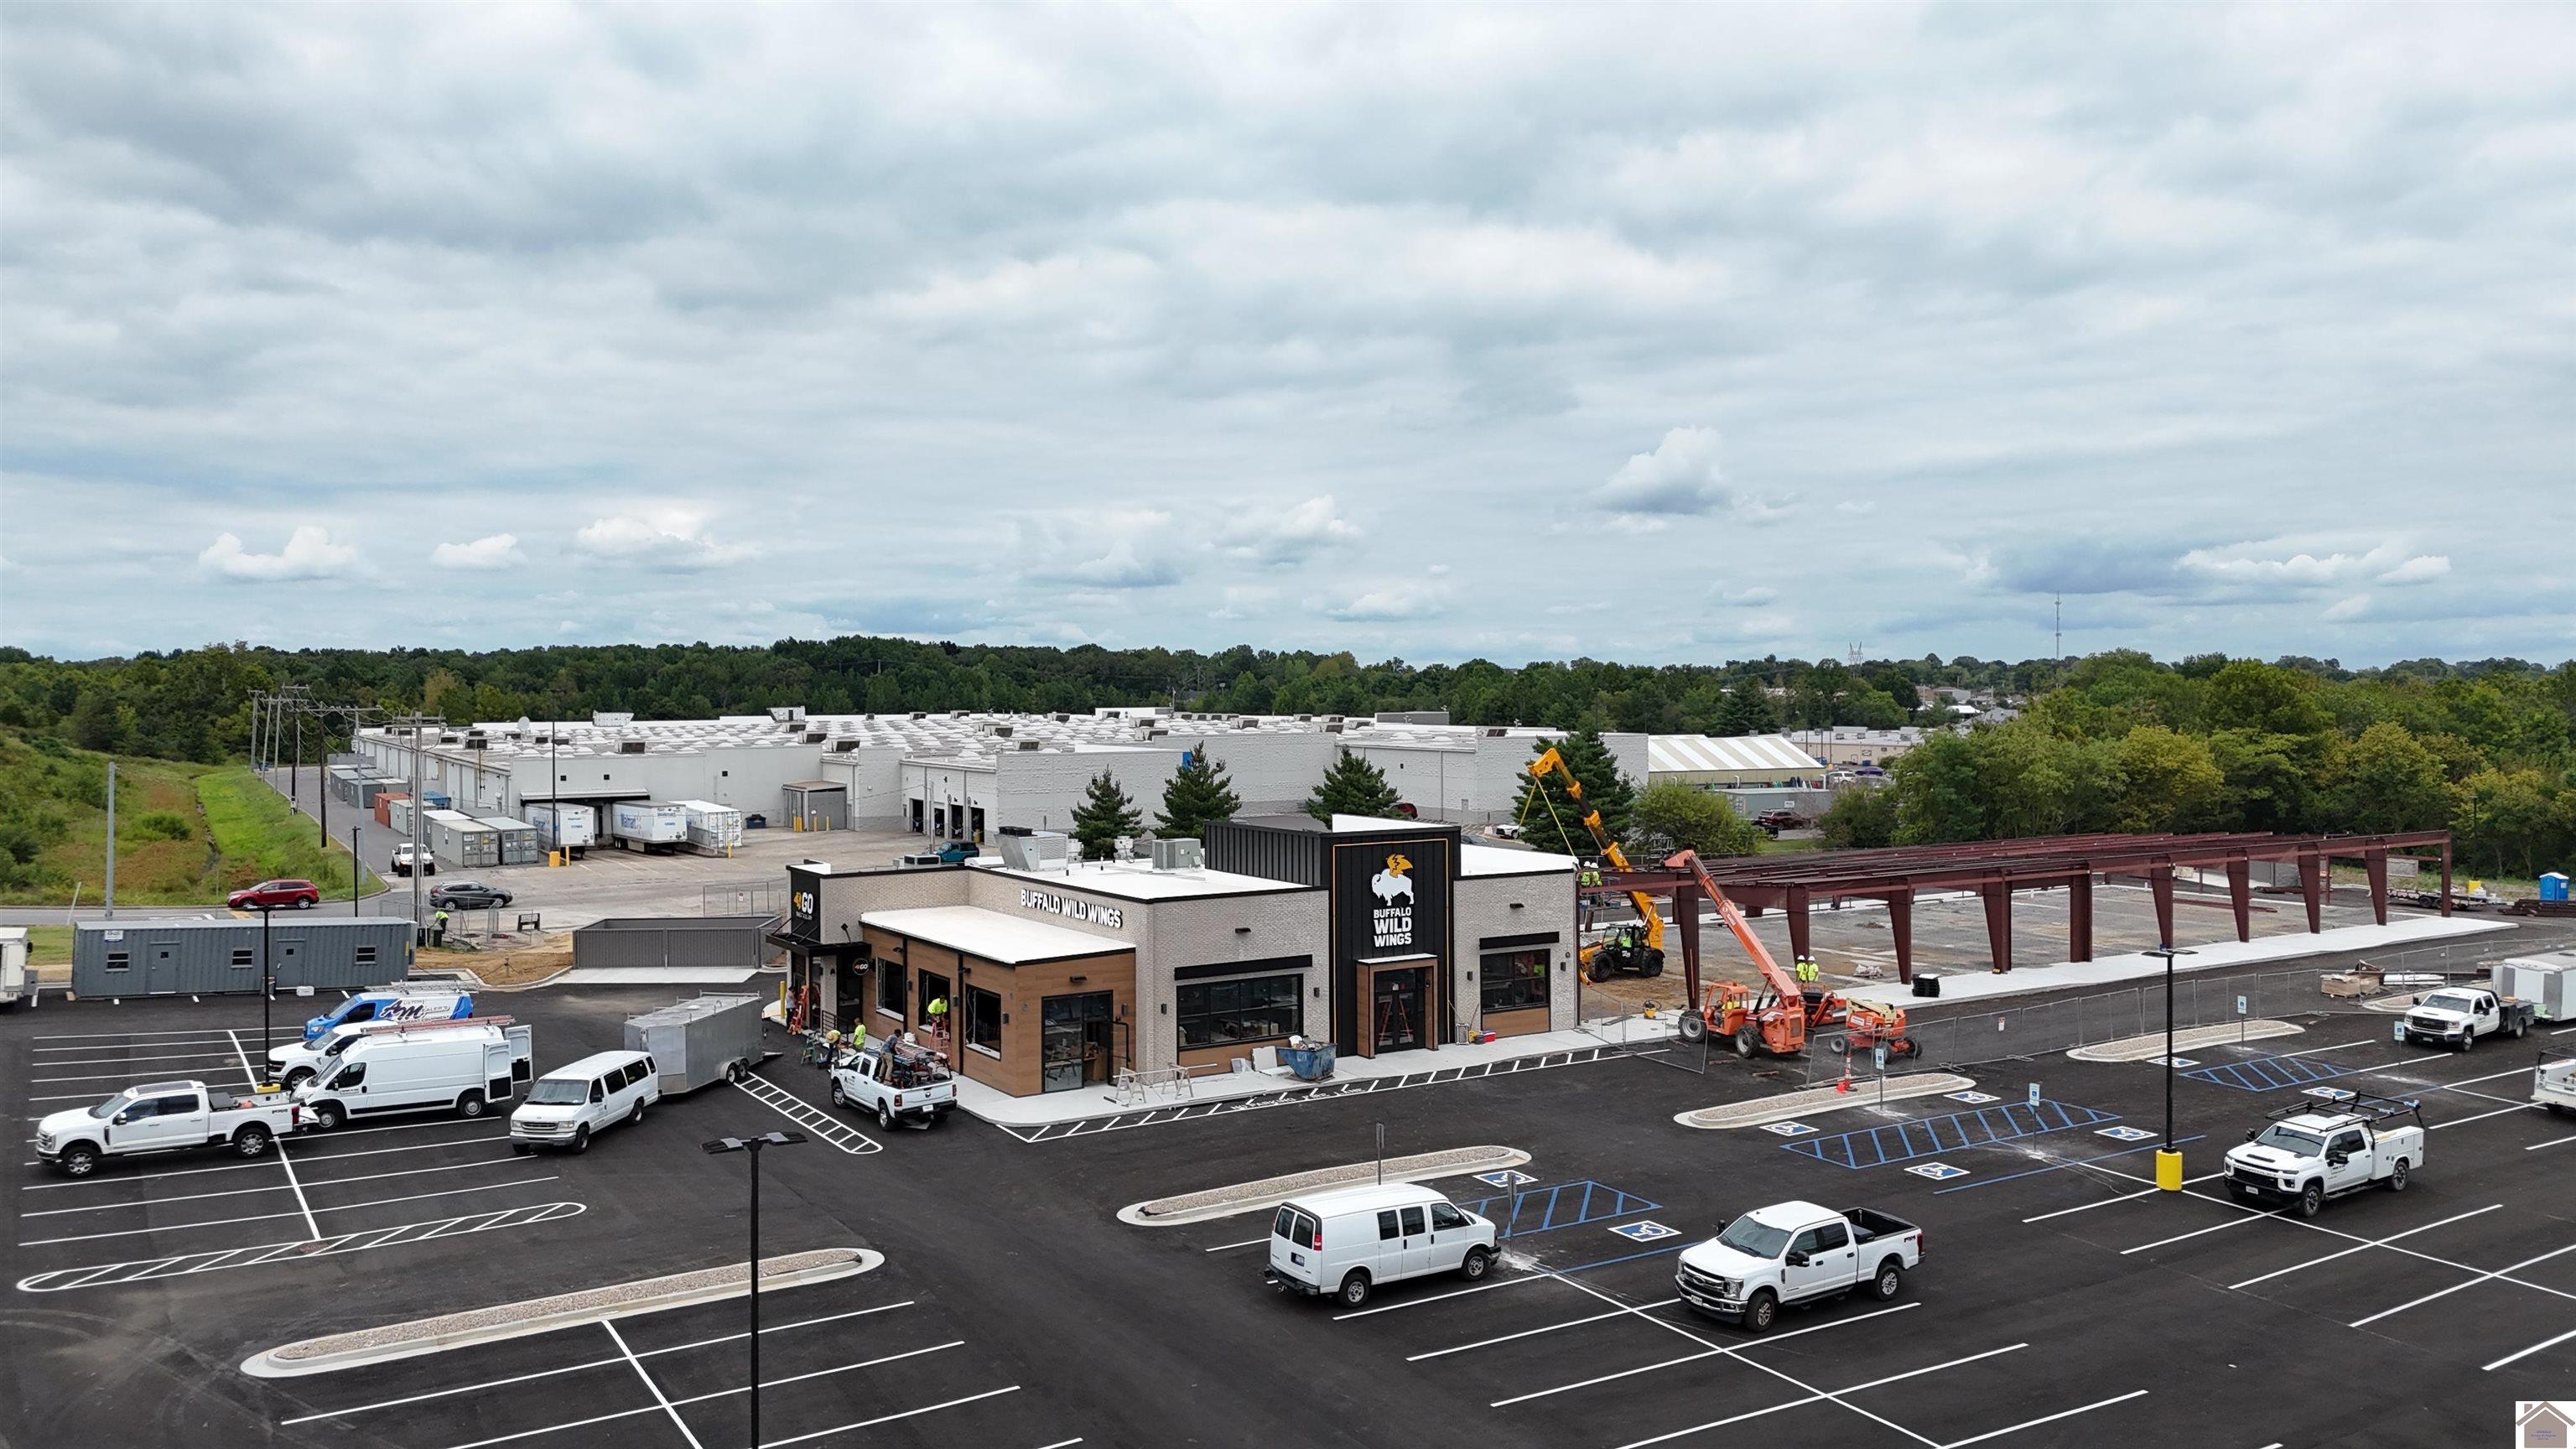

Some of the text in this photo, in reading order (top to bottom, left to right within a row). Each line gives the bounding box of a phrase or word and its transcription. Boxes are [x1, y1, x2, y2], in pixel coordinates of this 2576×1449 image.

[802, 892, 813, 914] GO
[1021, 889, 1123, 928] BUFFALO WILD WINGS
[1374, 906, 1412, 918] BUFFALO
[1374, 917, 1412, 934] WILD
[1374, 932, 1412, 948] WINGS
